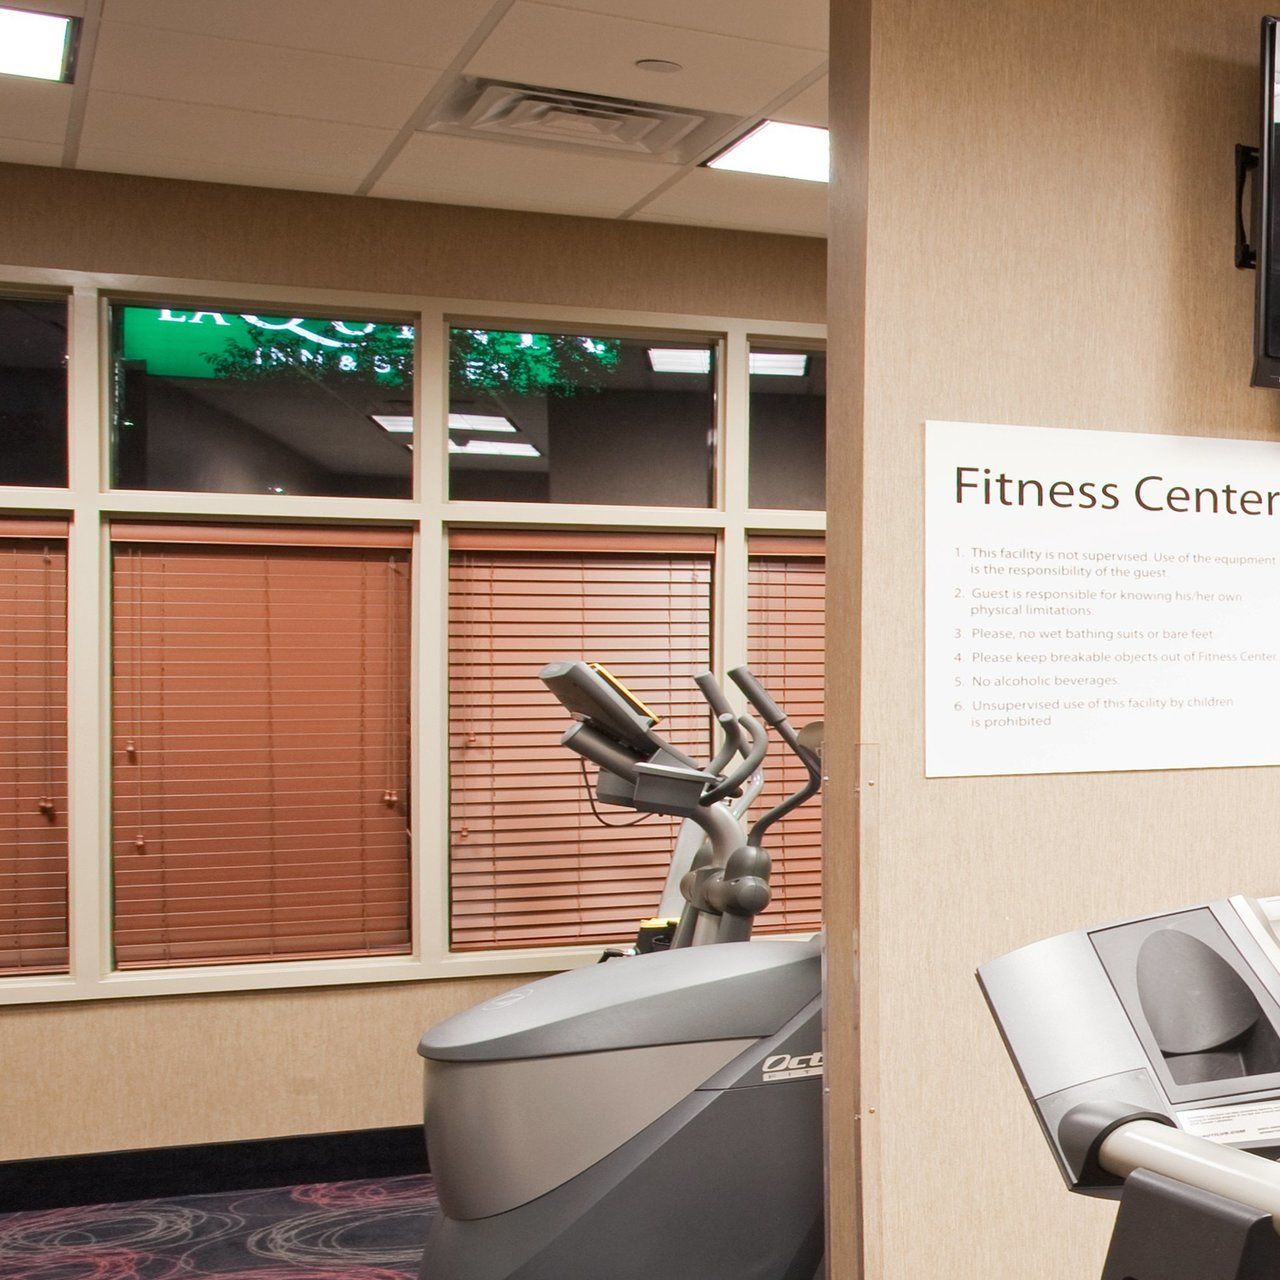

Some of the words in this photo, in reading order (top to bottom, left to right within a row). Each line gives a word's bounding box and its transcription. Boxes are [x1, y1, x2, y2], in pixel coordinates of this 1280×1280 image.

[956, 466, 1119, 509] Fitness
[1135, 475, 1280, 515] Center
[971, 547, 997, 559] This
[1000, 547, 1042, 561] facility
[1045, 550, 1055, 560] is
[1058, 551, 1079, 560] not
[1154, 552, 1175, 563] Use
[1178, 553, 1191, 563] of
[1193, 553, 1212, 564] the
[1214, 554, 1276, 566] equipment
[970, 564, 980, 574] is
[984, 564, 1005, 575] the
[1008, 565, 1092, 578] responsibility
[1095, 566, 1109, 577] of
[1110, 567, 1131, 577] the
[954, 588, 965, 599] 2.
[971, 588, 1009, 599] Guest
[1013, 589, 1022, 599] is
[1025, 589, 1097, 601] responsible
[1100, 590, 1118, 600] for
[1120, 590, 1172, 603] knowing
[1175, 591, 1214, 601] his/her
[1218, 593, 1242, 602] own
[970, 605, 1022, 617] physical
[971, 628, 1016, 640] Please,
[1019, 631, 1036, 639] no
[1039, 630, 1062, 639] wet
[1065, 629, 1114, 641] bathing
[1117, 629, 1144, 639] suits
[1147, 631, 1159, 639] or
[1162, 629, 1188, 639] bare
[972, 652, 1013, 662] Please
[1016, 652, 1047, 664] keep
[1050, 652, 1111, 662] breakable
[1114, 652, 1158, 664] objects
[1161, 653, 1181, 662] out
[1184, 651, 1195, 662] of
[1198, 652, 1238, 662] Fitness
[972, 676, 991, 687] No
[994, 676, 1051, 686] alcoholic
[954, 701, 965, 711] 6.
[972, 700, 1060, 712] Unsupervised
[1063, 702, 1085, 710] use
[1088, 699, 1101, 710] of
[1103, 699, 1126, 709] this
[1128, 698, 1167, 710] facility
[1170, 698, 1184, 709] by
[1187, 697, 1234, 707] children
[971, 718, 981, 728] is
[762, 1052, 824, 1072] Oct
